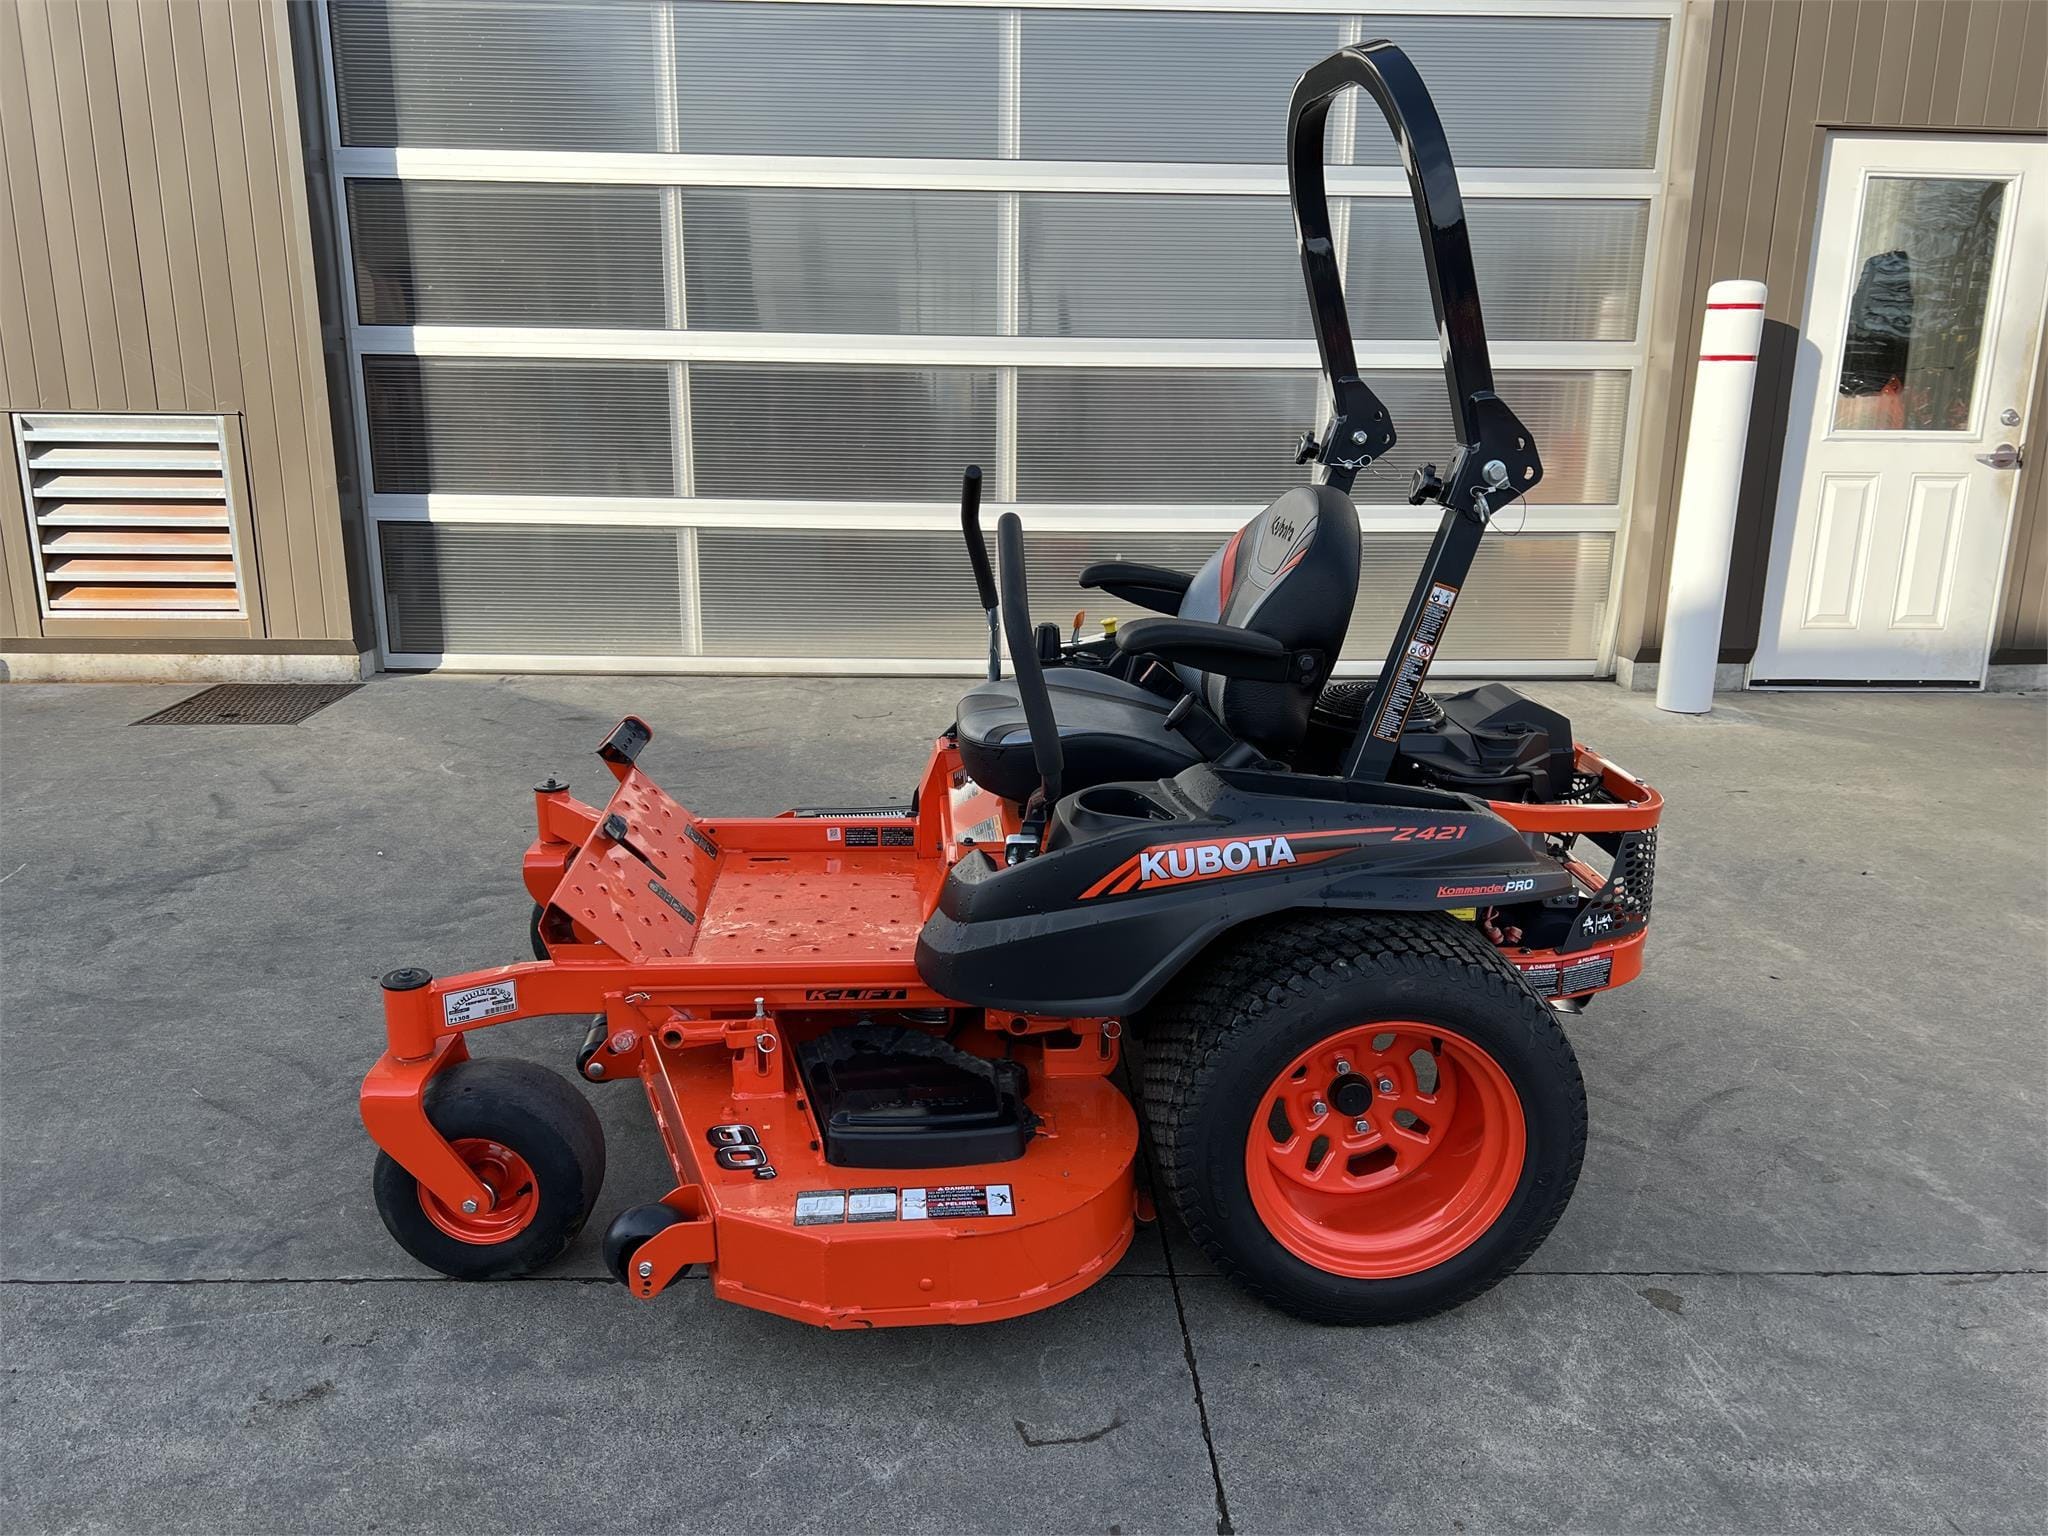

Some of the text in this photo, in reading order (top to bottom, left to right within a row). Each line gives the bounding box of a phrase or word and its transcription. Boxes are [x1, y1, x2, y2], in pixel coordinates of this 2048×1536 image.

[1390, 826, 1467, 841] Z421
[1139, 836, 1296, 881] KUBOTA
[808, 989, 905, 1001] K-LIFT
